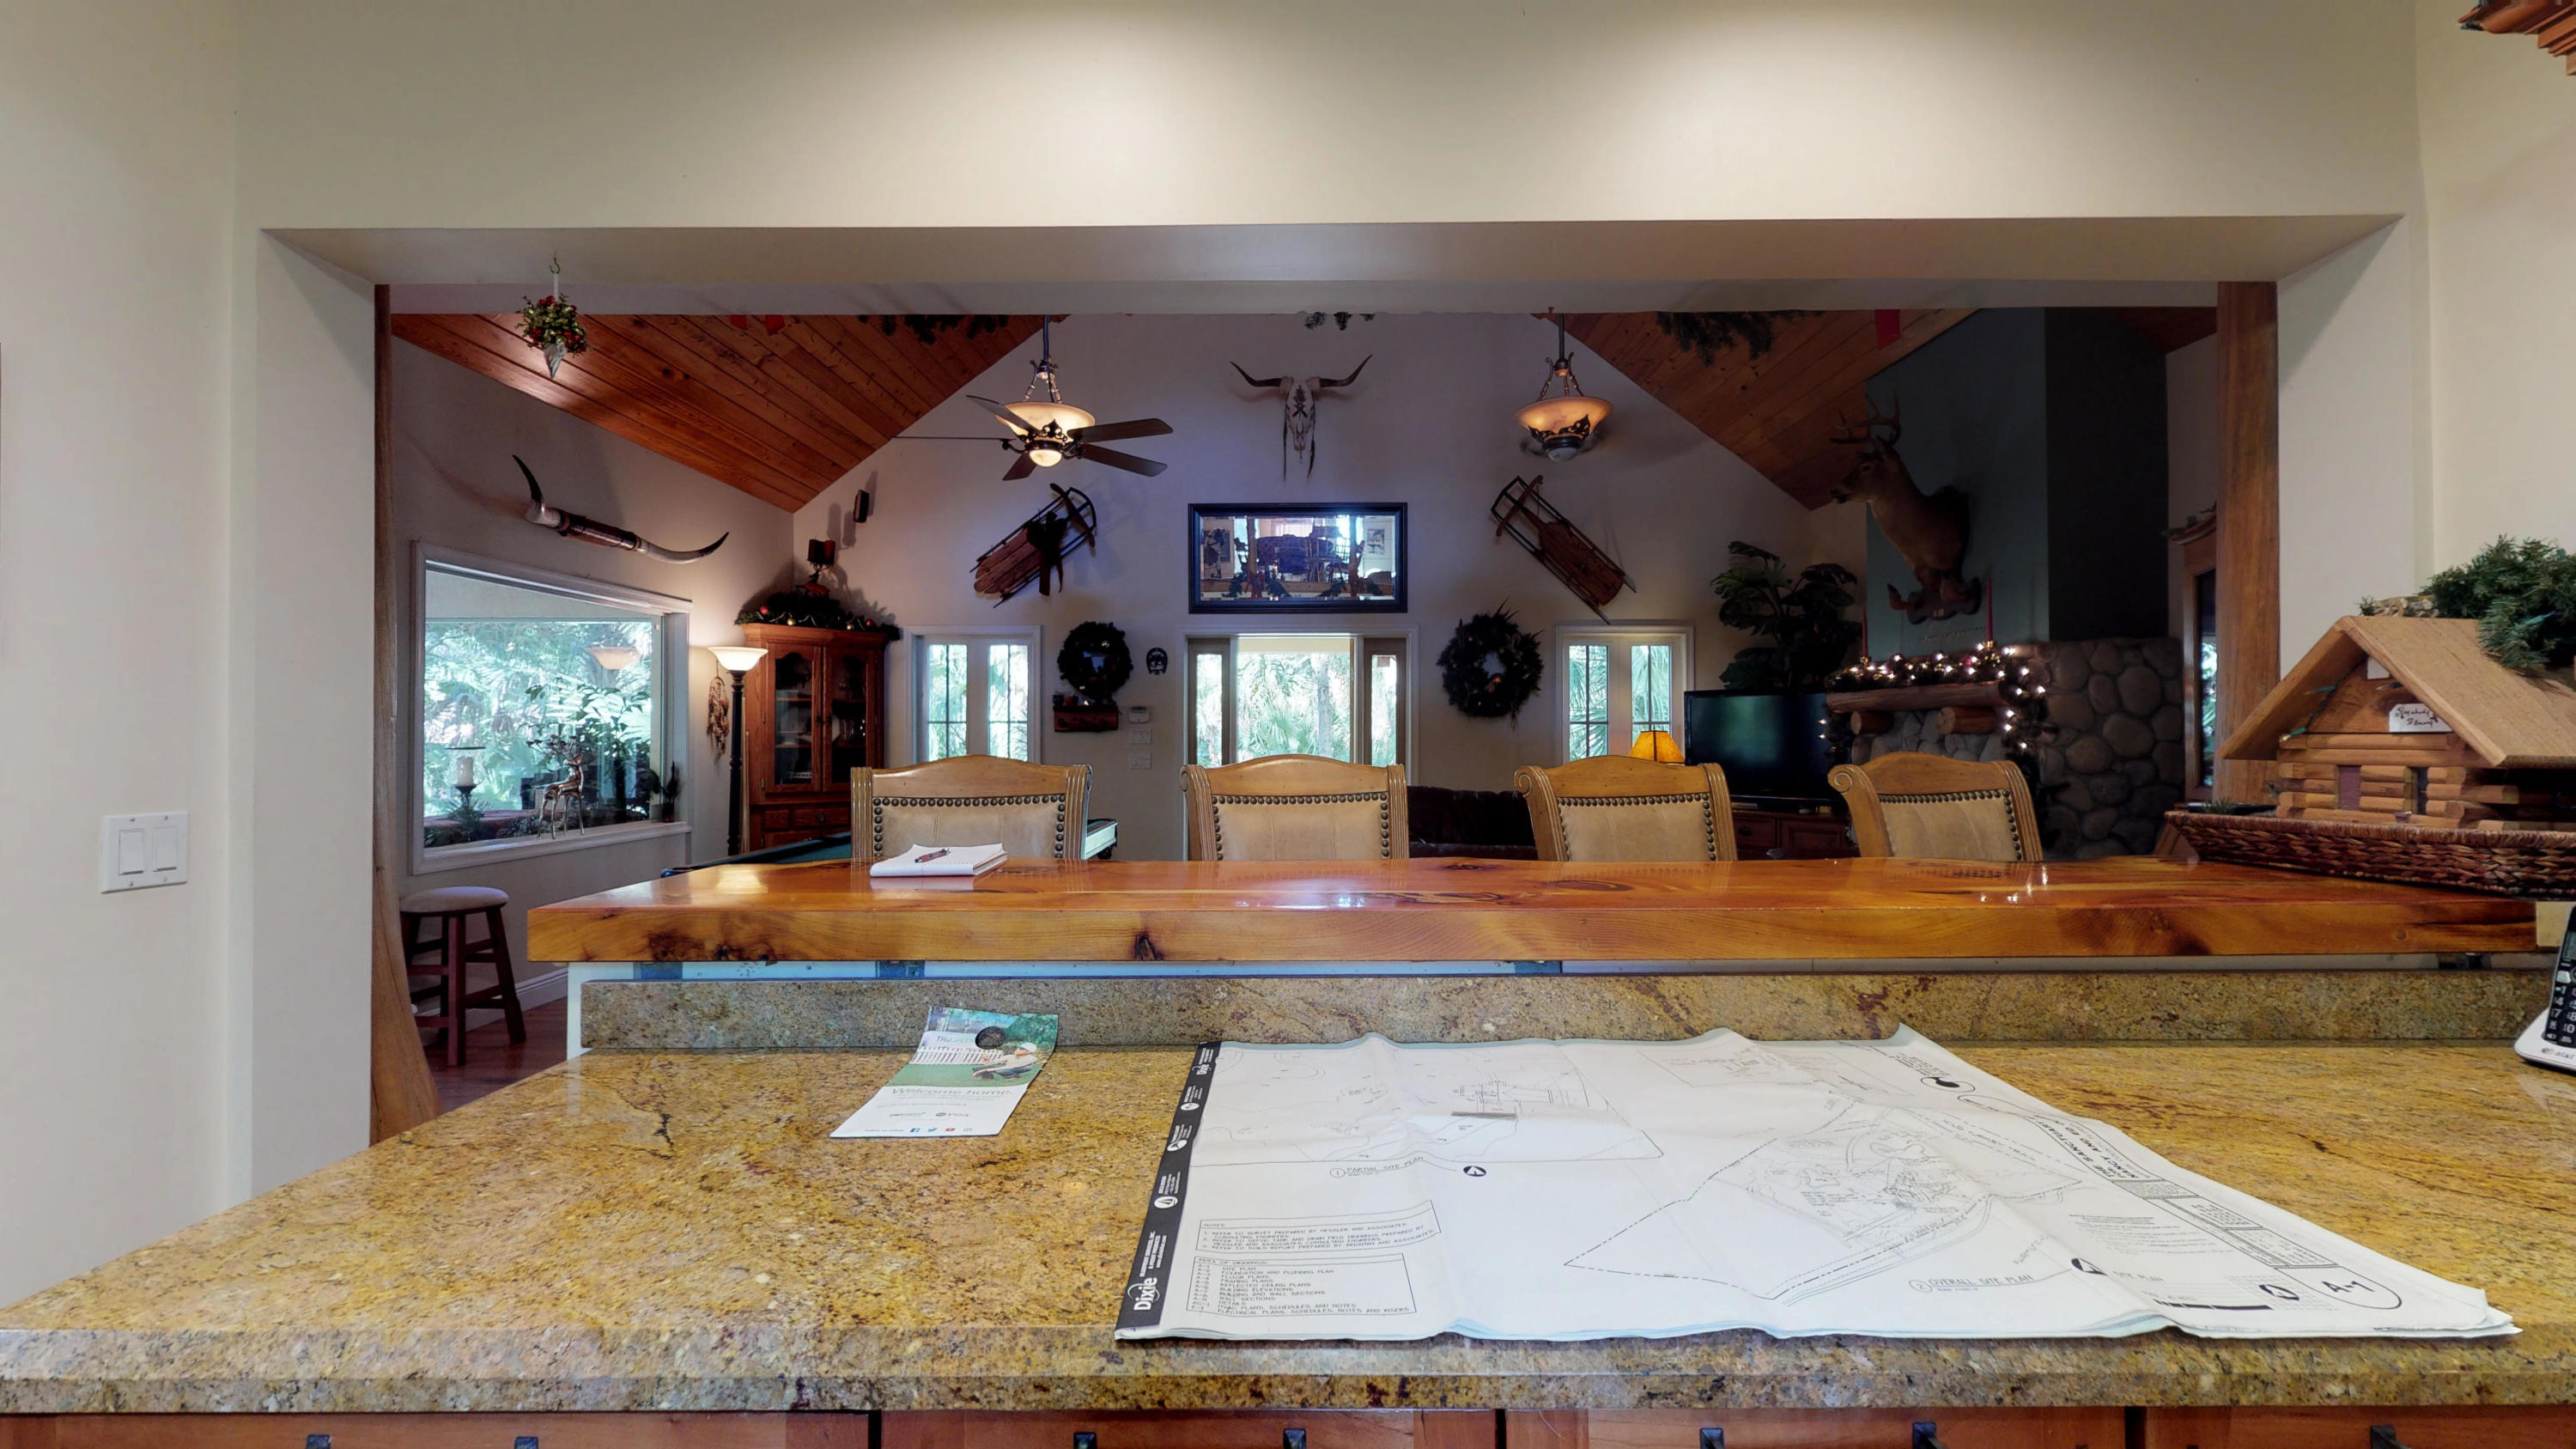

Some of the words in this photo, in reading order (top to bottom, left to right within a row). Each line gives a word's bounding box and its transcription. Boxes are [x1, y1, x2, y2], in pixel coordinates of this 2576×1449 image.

[2005, 1274, 2034, 1284] PLAN
[2321, 1281, 2375, 1293] A-1
[1133, 1277, 1158, 1311] Dixie
